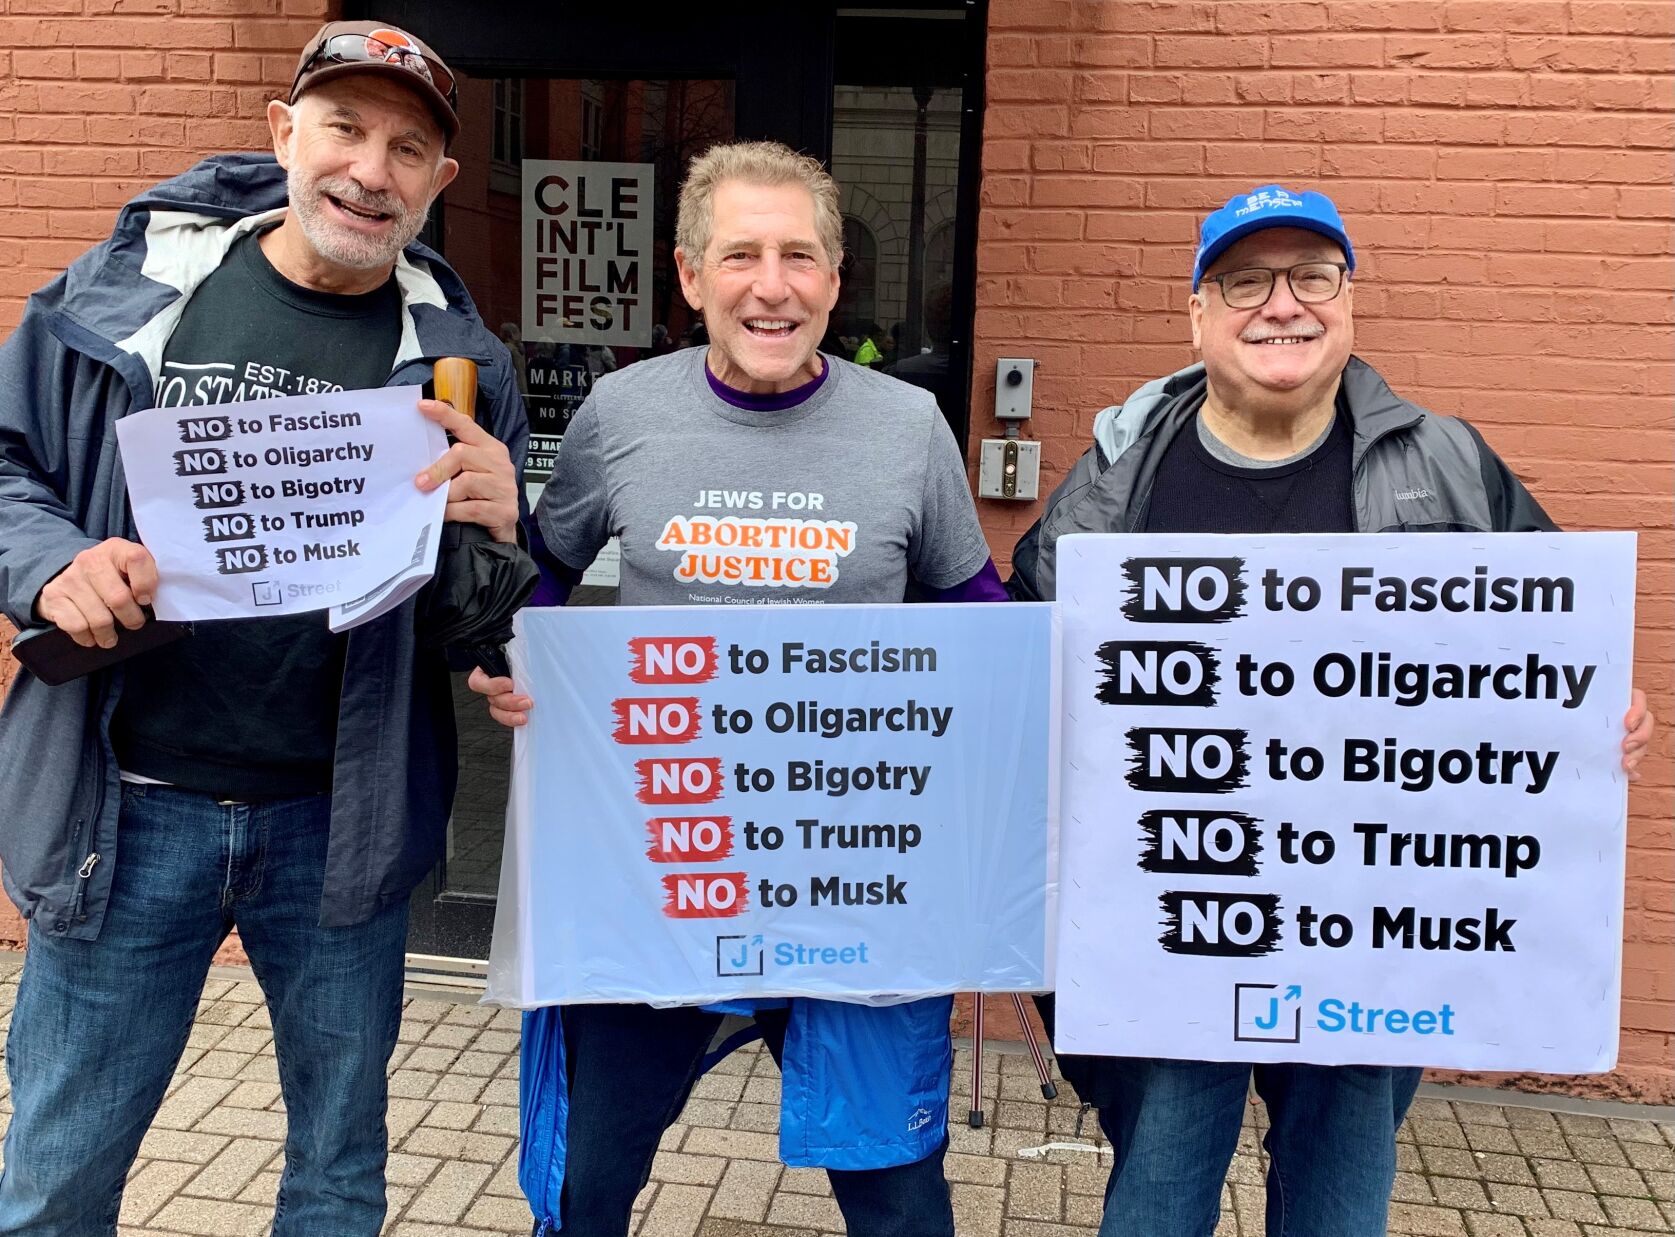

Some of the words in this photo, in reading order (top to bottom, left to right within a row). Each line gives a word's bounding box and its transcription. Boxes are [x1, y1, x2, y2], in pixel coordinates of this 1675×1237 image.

[534, 175, 639, 219] CLE
[537, 219, 639, 257] INT'L
[537, 257, 639, 295] FILM
[537, 294, 638, 331] FEST
[187, 419, 225, 438] NO
[238, 418, 263, 434] to
[269, 410, 362, 433] Fascism
[539, 407, 556, 418] NO
[184, 451, 220, 472] NO
[233, 451, 258, 468] to
[264, 441, 374, 467] Oligarchy
[201, 483, 239, 503] NO
[250, 483, 275, 500] to
[281, 477, 366, 499] Bigotry
[694, 490, 764, 510] JEWS
[772, 492, 824, 510] FOR
[212, 516, 249, 537] NO
[260, 514, 285, 531] to
[291, 509, 365, 530] Trump
[661, 522, 851, 552] ABORTION
[225, 548, 261, 570] NO
[273, 547, 297, 565] to
[303, 539, 361, 562] Musk
[679, 554, 832, 583] JUSTICE
[287, 579, 343, 598] Street
[688, 594, 722, 604] National
[724, 596, 755, 605] Council
[756, 597, 766, 605] of
[793, 597, 825, 605] Women
[1142, 565, 1230, 612] NO
[1261, 568, 1322, 613] to
[1340, 565, 1575, 613] Fascism
[644, 643, 706, 676] NO
[727, 643, 769, 675] to
[781, 640, 937, 674] Fascism
[1118, 650, 1204, 697] NO
[1236, 653, 1295, 697] to
[1312, 652, 1597, 709] Oligarchy
[628, 703, 690, 736] NO
[712, 704, 754, 734] to
[765, 699, 954, 739] Oligarchy
[652, 762, 713, 795] NO
[734, 762, 776, 793] to
[787, 759, 932, 796] Bigotry
[1148, 734, 1233, 780] NO
[1266, 738, 1324, 781] to
[1343, 737, 1560, 794] Bigotry
[661, 821, 722, 853] NO
[743, 820, 785, 851] to
[795, 819, 923, 854] Trump
[1161, 817, 1246, 862] NO
[1277, 822, 1336, 865] to
[1353, 822, 1542, 878] Trump
[677, 878, 737, 910] NO
[758, 878, 798, 908] to
[810, 875, 908, 907] Musk
[1180, 900, 1265, 946] NO
[1297, 905, 1354, 948] to
[1371, 906, 1518, 953] Musk
[730, 943, 748, 968] J
[774, 941, 869, 967] Street
[1254, 997, 1279, 1030] J
[1316, 998, 1455, 1036] Street
